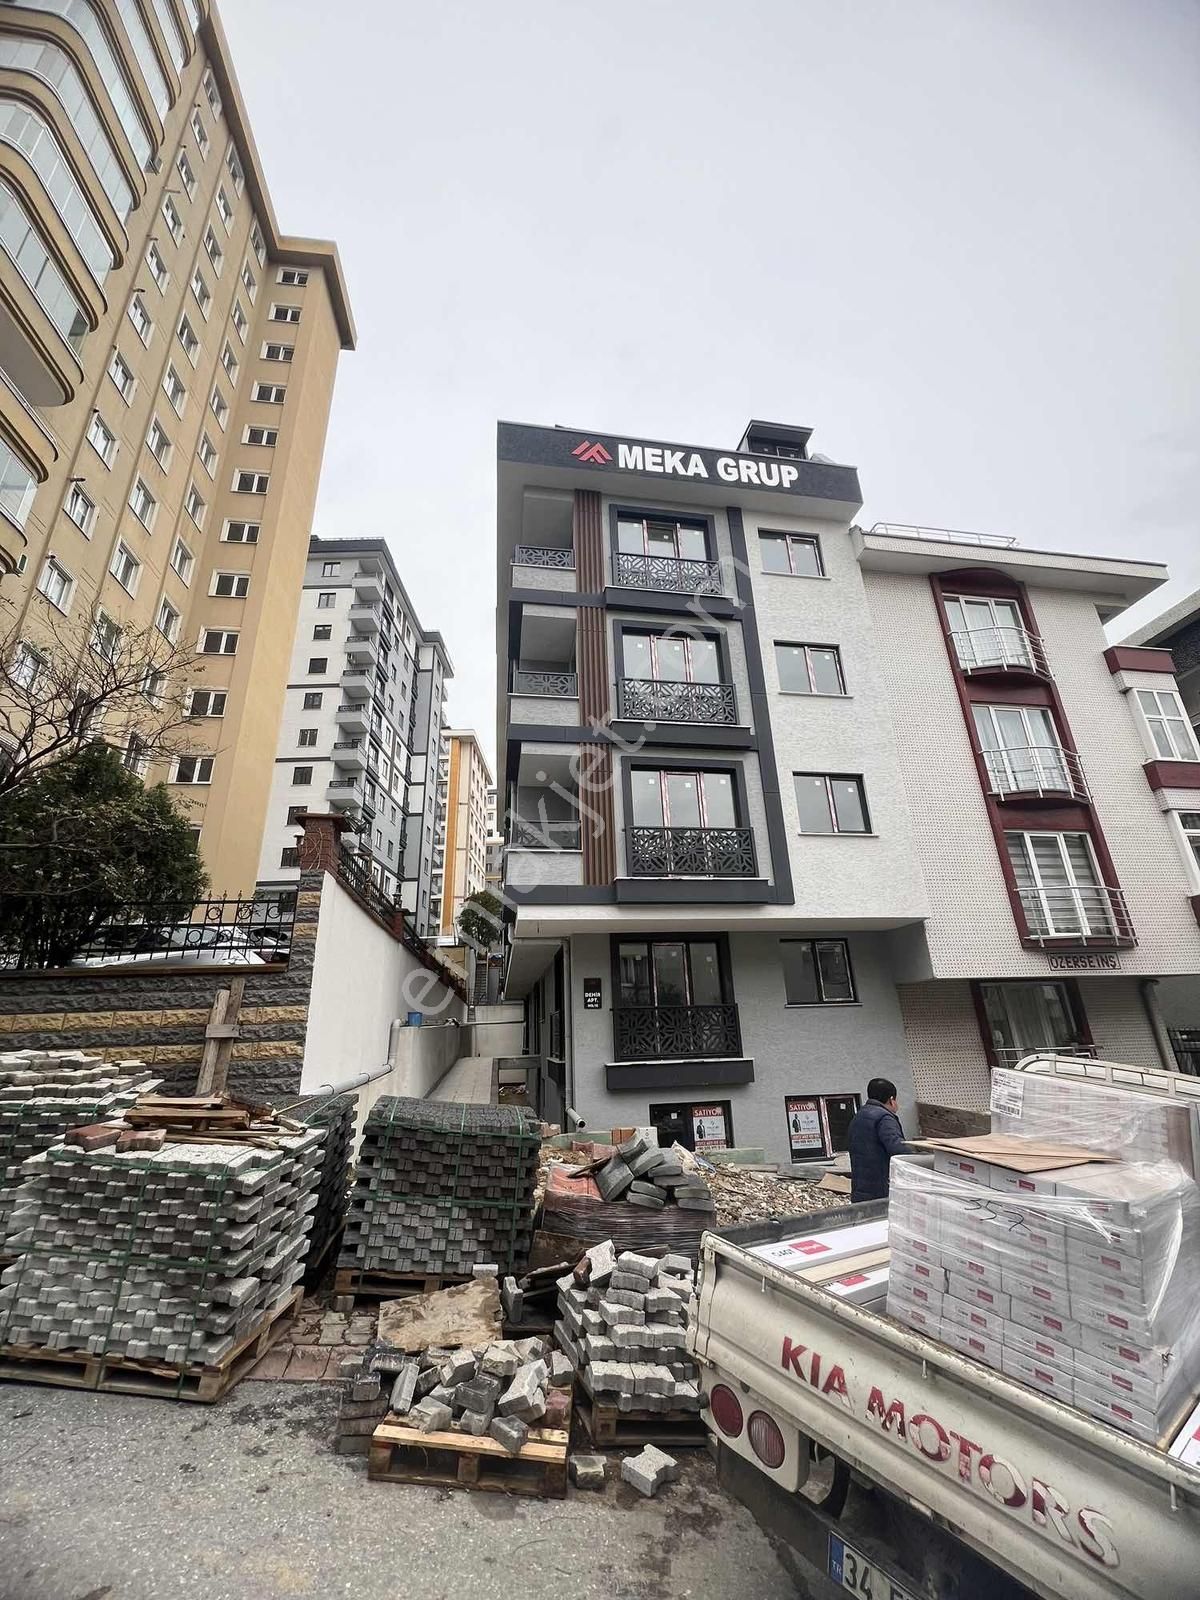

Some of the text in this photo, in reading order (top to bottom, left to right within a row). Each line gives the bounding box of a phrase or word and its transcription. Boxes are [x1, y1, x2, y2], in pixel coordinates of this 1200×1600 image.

[617, 443, 799, 488] MEKA GRUP
[781, 1335, 1121, 1569] KIA MOTORS
